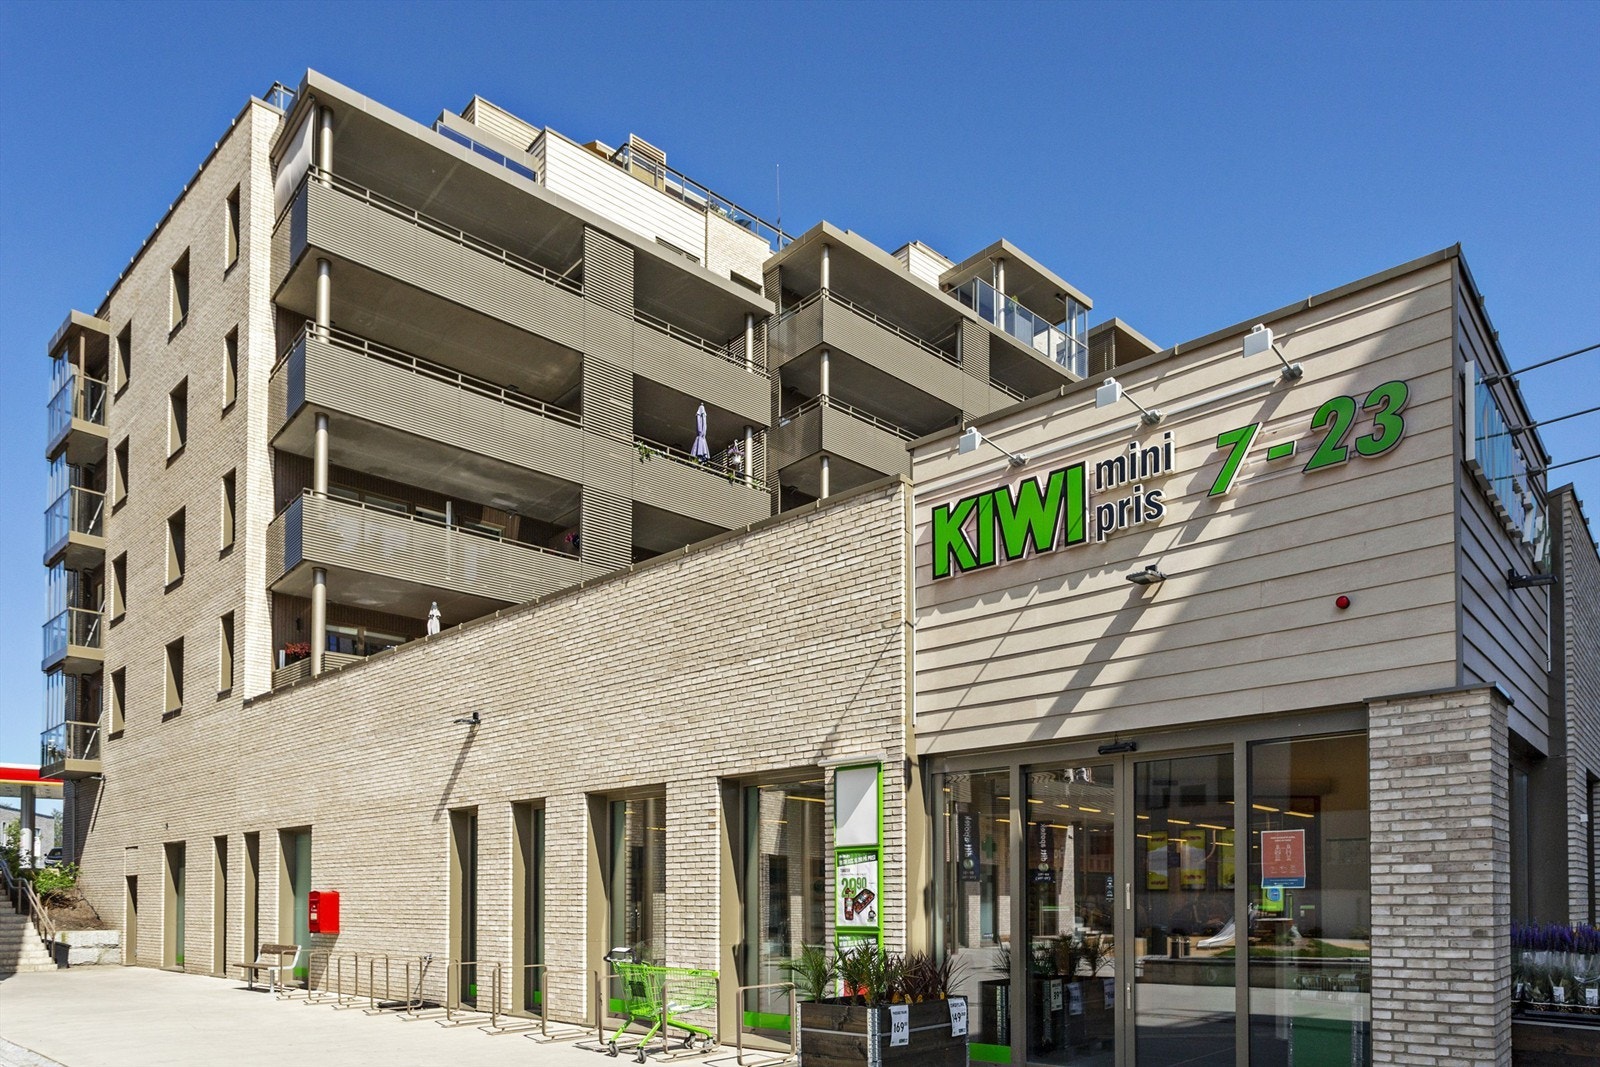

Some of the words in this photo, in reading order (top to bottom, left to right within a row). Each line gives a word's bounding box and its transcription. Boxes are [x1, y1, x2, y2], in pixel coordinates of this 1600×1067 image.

[1095, 431, 1176, 493] mini
[1207, 422, 1263, 498] 7
[1302, 379, 1411, 474] 23
[932, 460, 1089, 580] KIWI
[1095, 483, 1167, 543] pris
